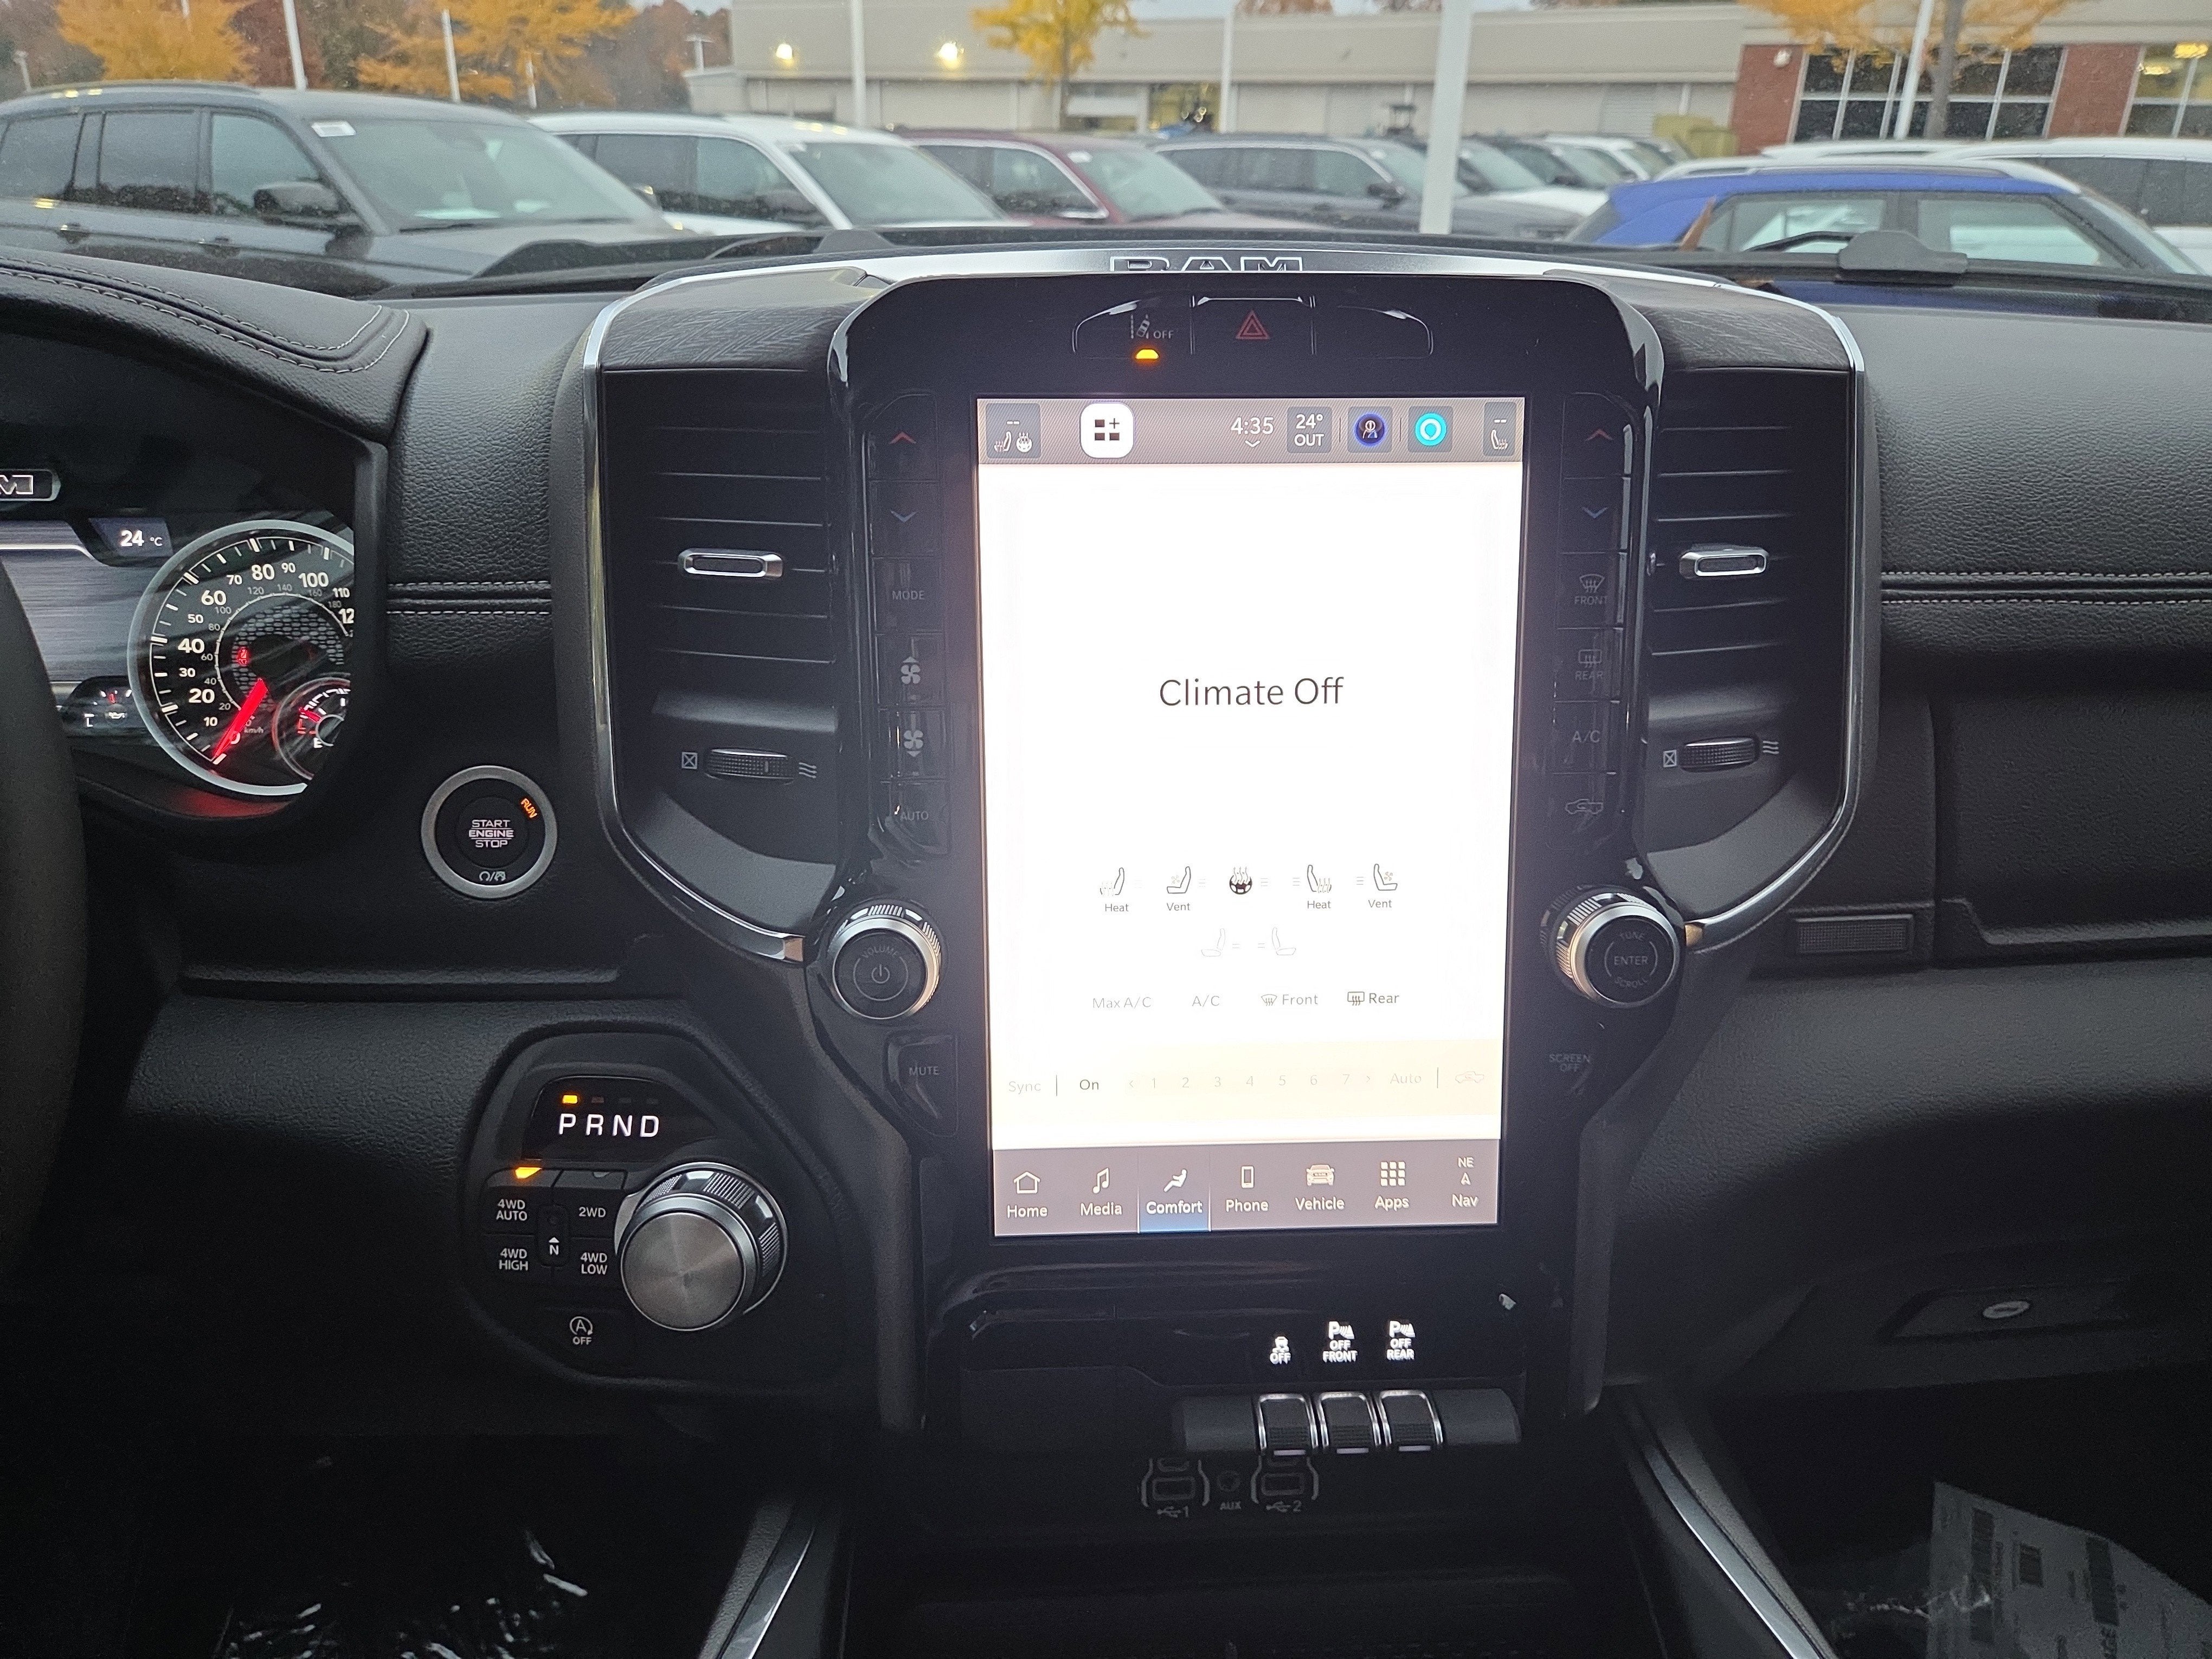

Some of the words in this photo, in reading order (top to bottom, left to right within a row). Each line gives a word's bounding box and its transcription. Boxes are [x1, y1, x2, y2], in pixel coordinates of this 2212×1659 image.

[1110, 256, 1302, 271] RAM
[1153, 330, 1174, 339] OFF
[1231, 417, 1274, 434] 4:35
[1296, 414, 1323, 429] 24°
[1294, 434, 1324, 446] OUT
[120, 530, 144, 547] 24
[251, 563, 275, 581] 80
[281, 562, 296, 573] 90
[226, 575, 242, 584] 70
[298, 572, 329, 588] 100
[247, 587, 265, 595] 120
[308, 589, 323, 597] 160
[332, 588, 350, 598] 110
[892, 590, 925, 600] MODE
[201, 590, 227, 606] 60
[328, 600, 342, 608] 180
[188, 614, 204, 623] 50
[178, 638, 205, 653] 40
[179, 667, 196, 678] 30
[1576, 672, 1603, 680] REAR
[189, 688, 215, 704] 20
[1160, 678, 1284, 706] Climate
[1294, 676, 1344, 704] Off
[203, 717, 218, 726] 10
[1573, 731, 1600, 743] A/C
[520, 798, 537, 818] RUN
[899, 811, 929, 821] AUTO
[472, 819, 511, 828] START
[468, 829, 514, 838] ENGINE
[475, 840, 508, 848] STOP
[1104, 903, 1129, 913] Heat
[1166, 902, 1191, 912] Vent
[1307, 899, 1332, 910] Heat
[1368, 898, 1393, 909] Vent
[1615, 956, 1648, 965] ENTER
[1092, 996, 1121, 1009] Max
[1123, 995, 1152, 1009] A/C
[1192, 995, 1221, 1008] A/C
[1282, 993, 1319, 1006] Front
[1368, 992, 1400, 1005] Rear
[909, 1066, 940, 1076] MUTE
[1151, 1077, 1156, 1089] 1
[1182, 1077, 1189, 1088] 2
[1214, 1076, 1221, 1088] 3
[1246, 1076, 1254, 1086] 4
[1278, 1075, 1286, 1086] 5
[1310, 1075, 1318, 1085] 6
[1342, 1074, 1351, 1085] 7
[1390, 1073, 1422, 1084] Auto
[1008, 1081, 1041, 1095] Sync
[1079, 1079, 1099, 1091] On
[558, 1113, 577, 1135] P
[586, 1114, 603, 1136] R
[613, 1115, 633, 1137] N
[640, 1115, 660, 1138] D
[1458, 1157, 1474, 1168] NE
[498, 1199, 526, 1210] 4WD
[1225, 1198, 1269, 1212] Phone
[1295, 1196, 1345, 1211] Vehicle
[1374, 1195, 1410, 1212] Apps
[1451, 1194, 1479, 1208] Nav
[578, 1207, 607, 1218] 2WD
[1006, 1205, 1048, 1219] Home
[1079, 1202, 1122, 1216] Media
[1146, 1200, 1203, 1215] Comfort
[496, 1210, 528, 1221] AUTO
[500, 1249, 528, 1259] 4WD
[549, 1245, 559, 1255] N
[580, 1252, 608, 1264] 4WD
[498, 1259, 529, 1271] HIGH
[581, 1264, 608, 1275] LOW
[573, 1336, 591, 1345] OFF
[1329, 1340, 1351, 1351] OFF
[1390, 1338, 1412, 1349] OFF
[1269, 1352, 1291, 1365] OFF
[1322, 1350, 1358, 1363] FRONT
[1386, 1348, 1414, 1361] REAR
[1220, 1501, 1242, 1510] AUX
